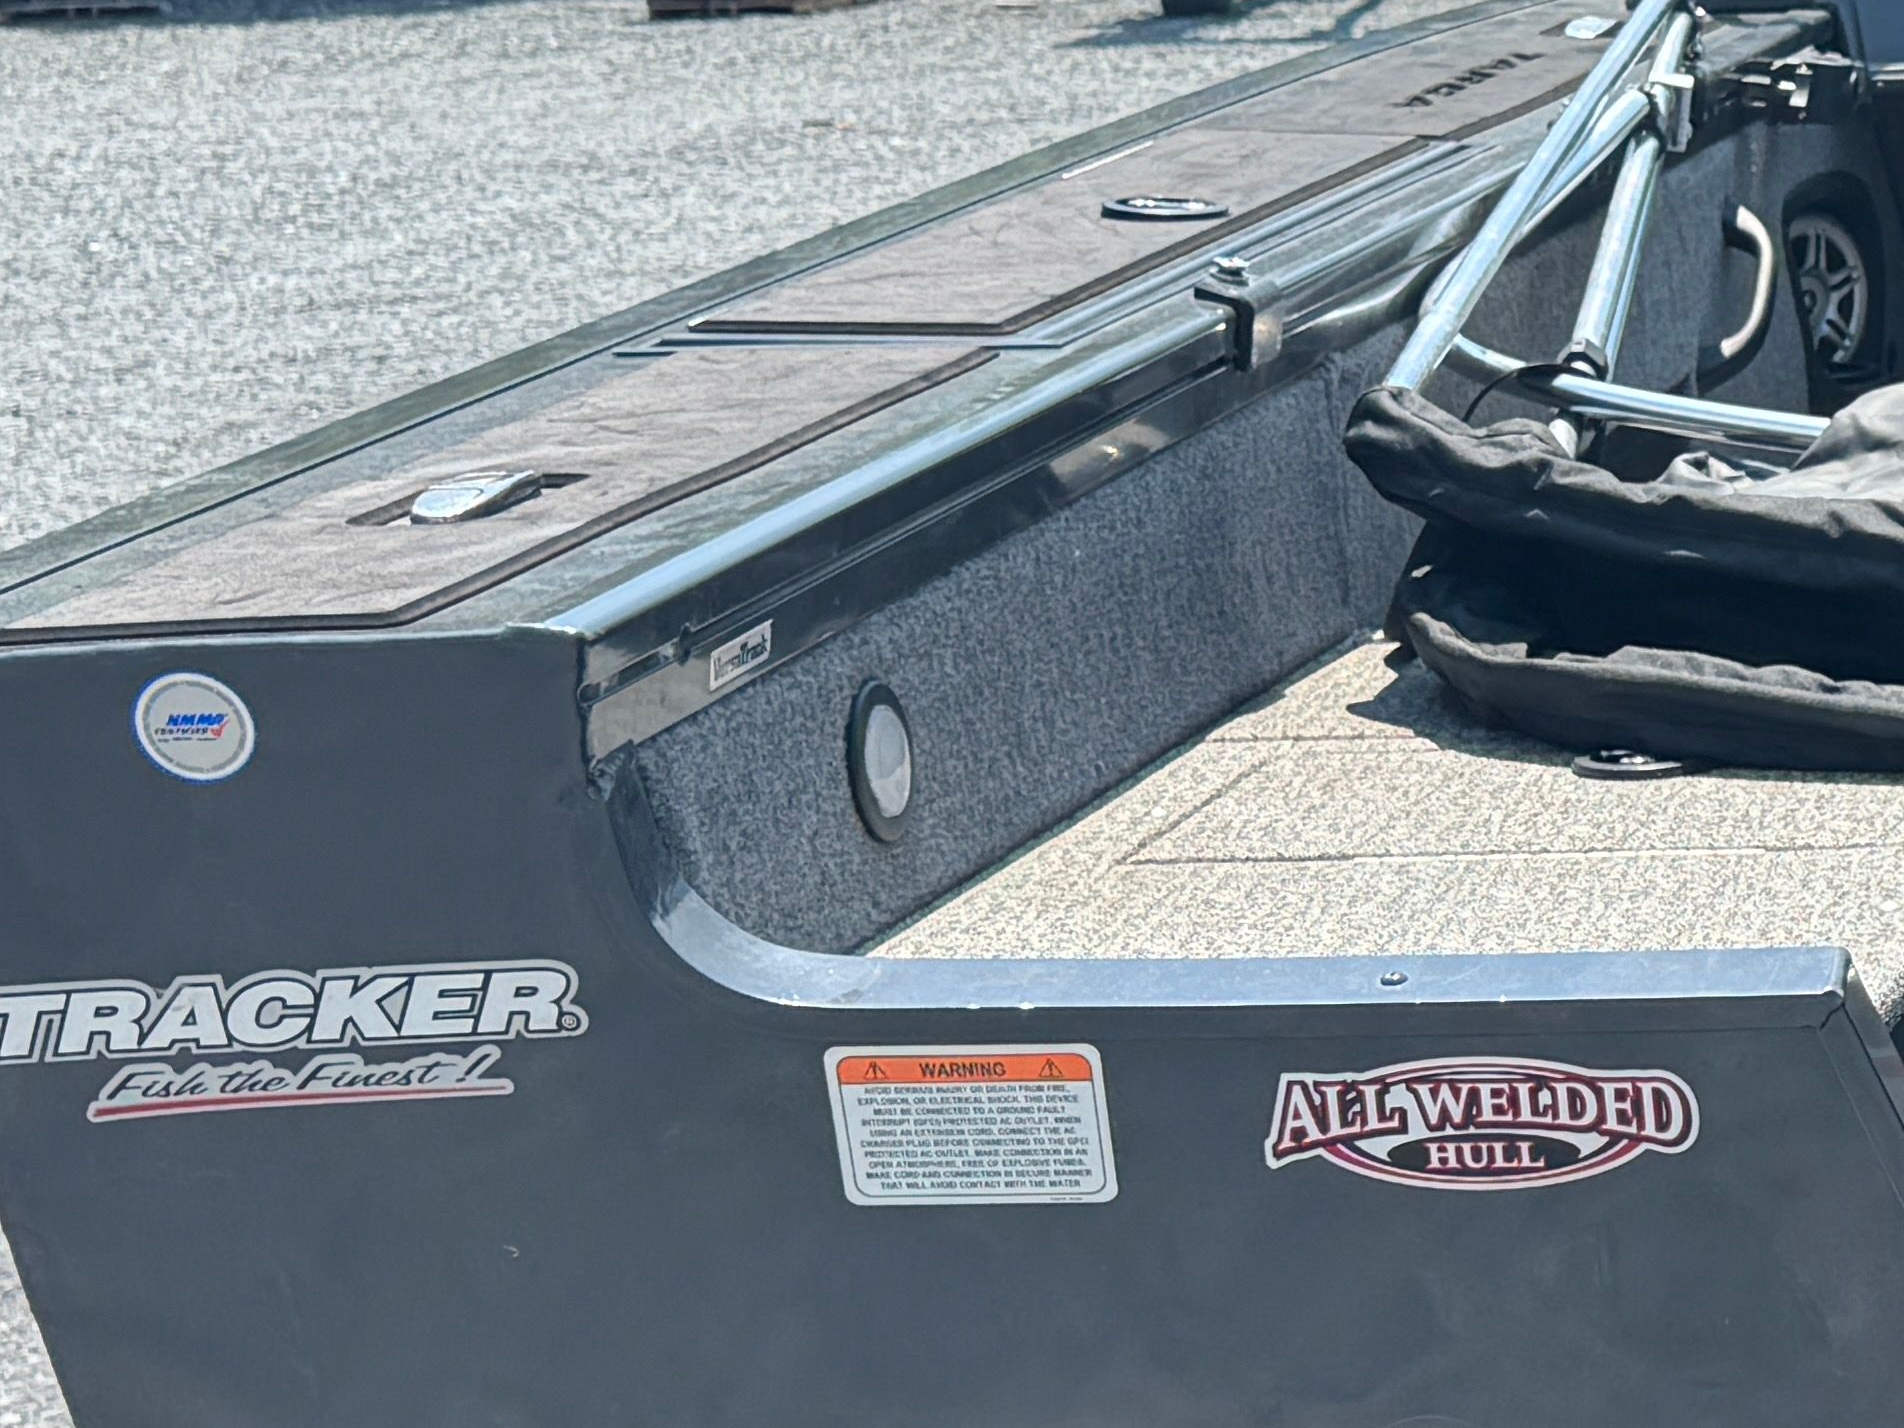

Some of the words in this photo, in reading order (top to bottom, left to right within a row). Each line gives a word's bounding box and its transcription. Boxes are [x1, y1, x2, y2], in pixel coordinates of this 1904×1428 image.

[106, 1071, 208, 1100] Fish
[220, 1068, 291, 1094] the
[297, 1057, 441, 1091] Finest
[919, 1062, 1007, 1078] WARNING
[1276, 1079, 1403, 1152] ALL
[1407, 1080, 1686, 1141] WELDED
[1424, 1140, 1546, 1169] HULL
